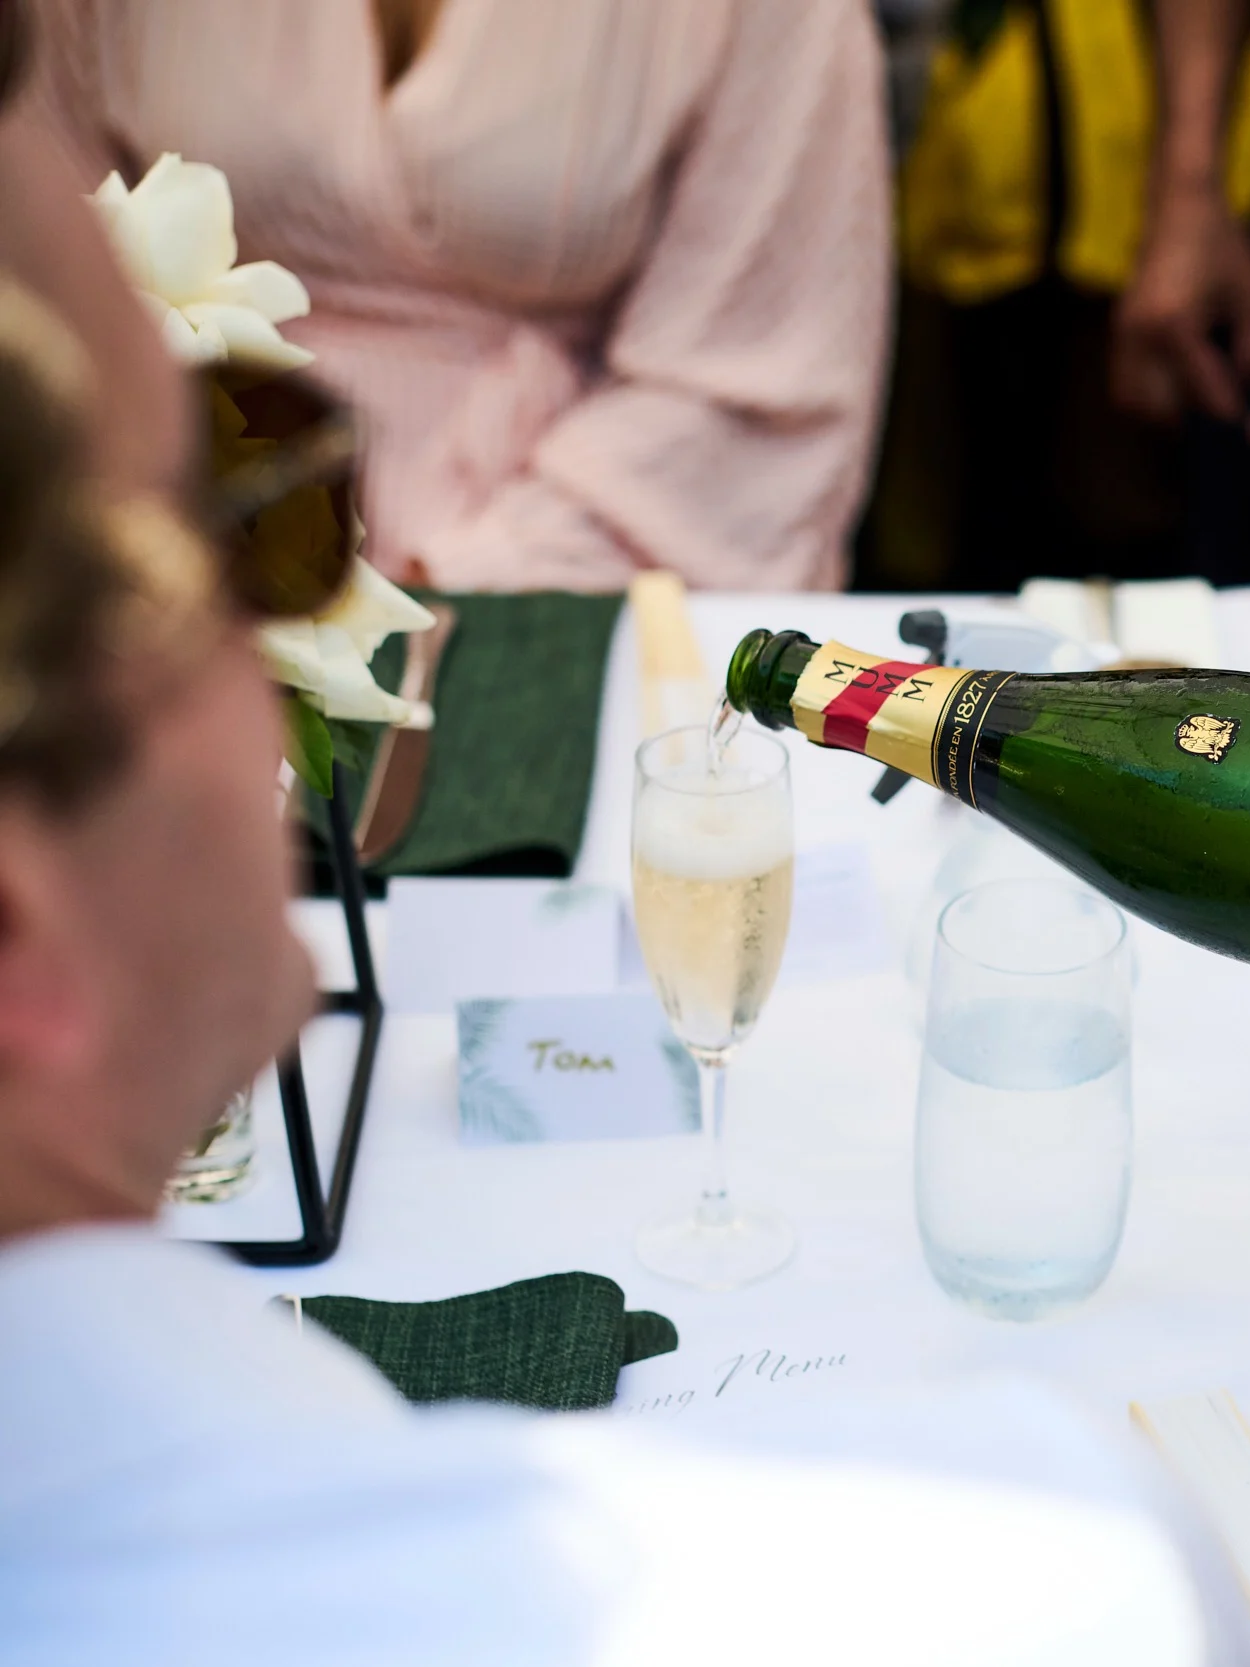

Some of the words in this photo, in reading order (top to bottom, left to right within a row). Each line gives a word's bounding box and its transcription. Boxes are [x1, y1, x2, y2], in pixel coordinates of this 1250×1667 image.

[824, 661, 934, 702] MUMM
[954, 680, 987, 724] 1827
[952, 726, 963, 746] EN
[714, 1349, 847, 1397] Menu
